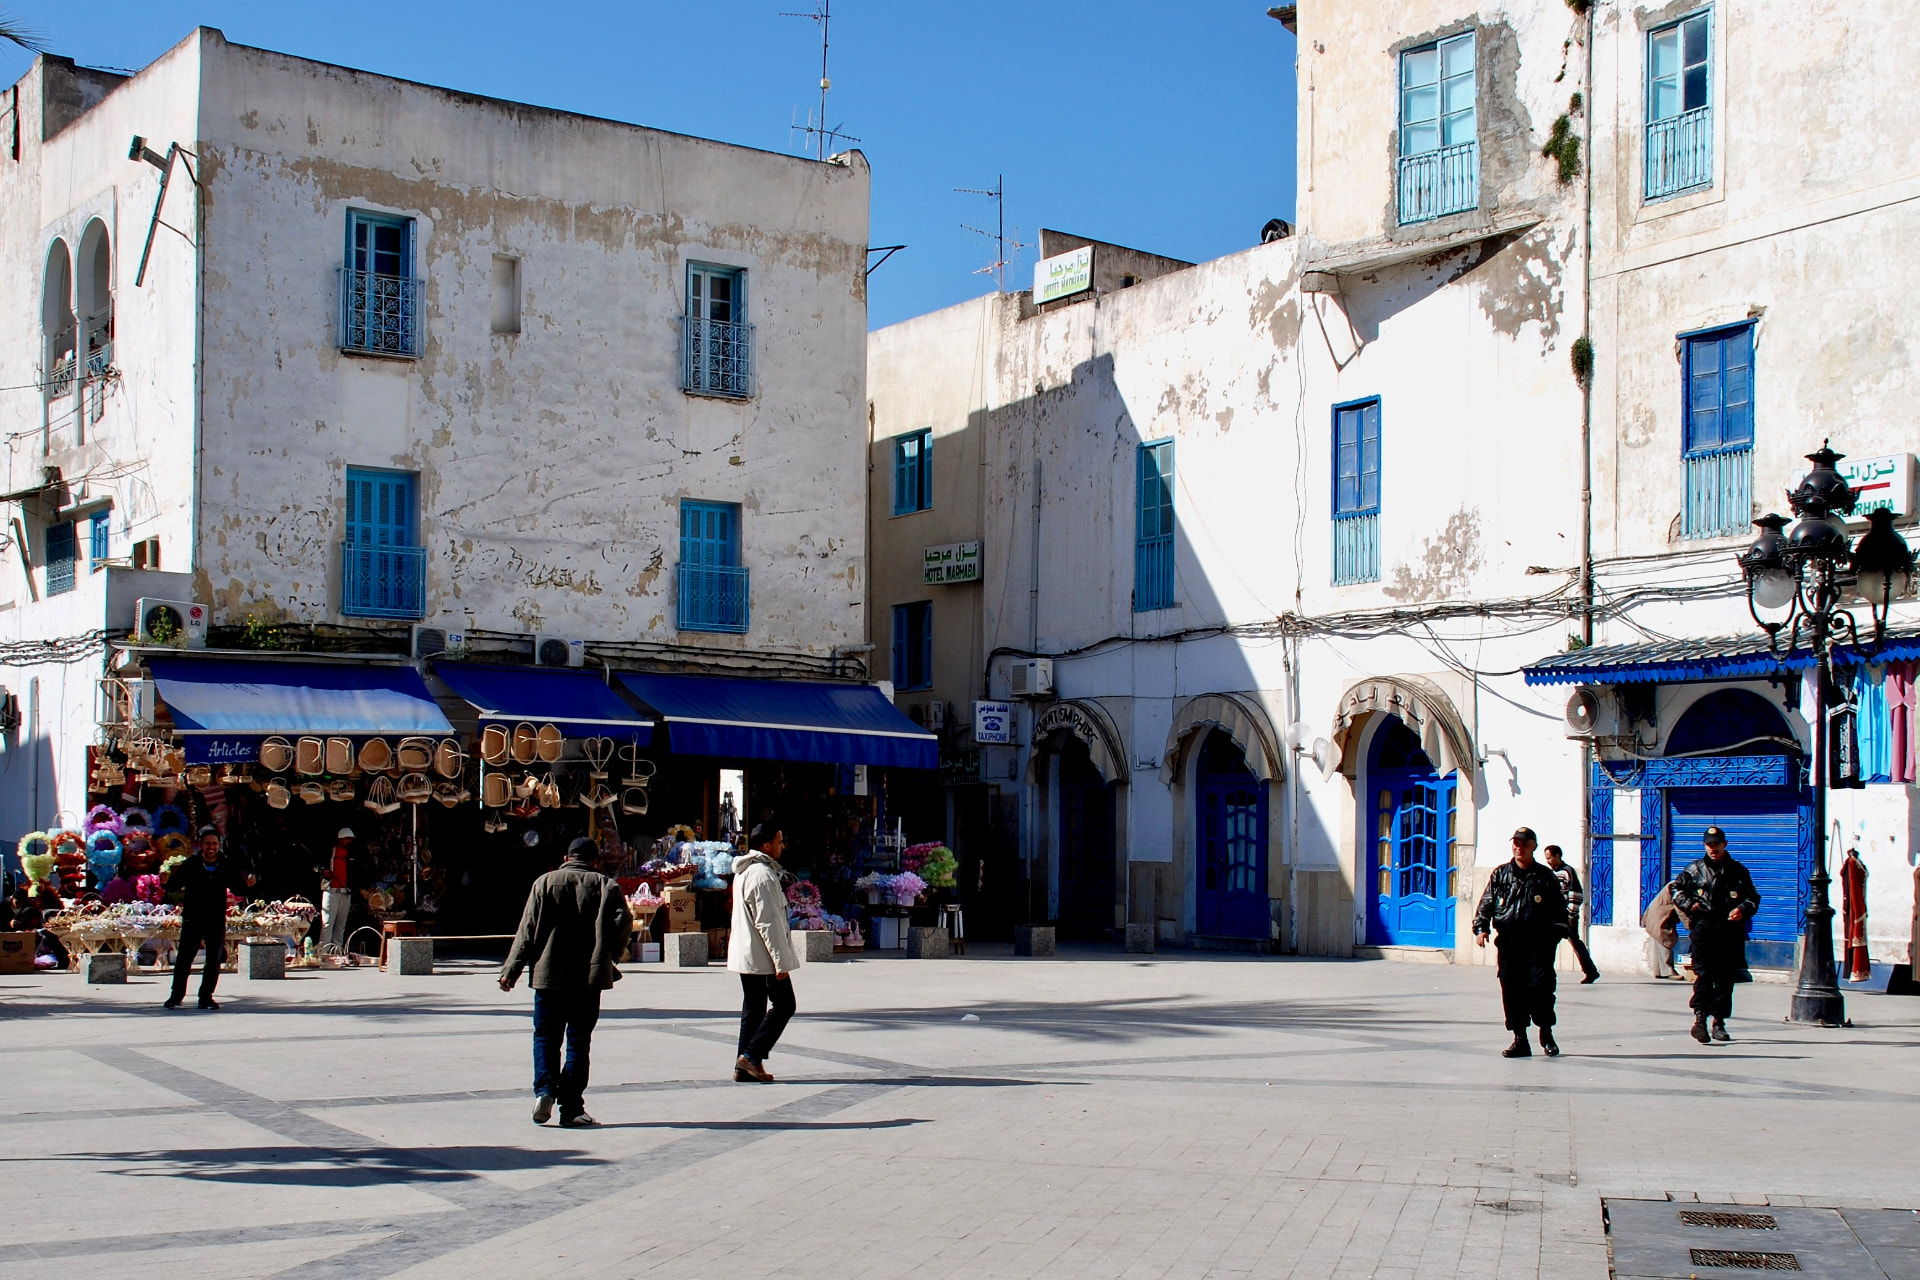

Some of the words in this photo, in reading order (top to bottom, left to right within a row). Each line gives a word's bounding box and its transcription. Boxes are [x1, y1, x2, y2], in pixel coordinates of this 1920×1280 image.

[1861, 459, 1894, 481] نزل
[925, 549, 951, 566] مرحبا
[956, 543, 977, 562] نزل
[925, 567, 944, 583] HOTEL
[946, 563, 976, 580] MARHABA
[190, 619, 201, 627] LG
[977, 731, 1008, 742] TAXIPHONE
[208, 740, 251, 757] Articles
